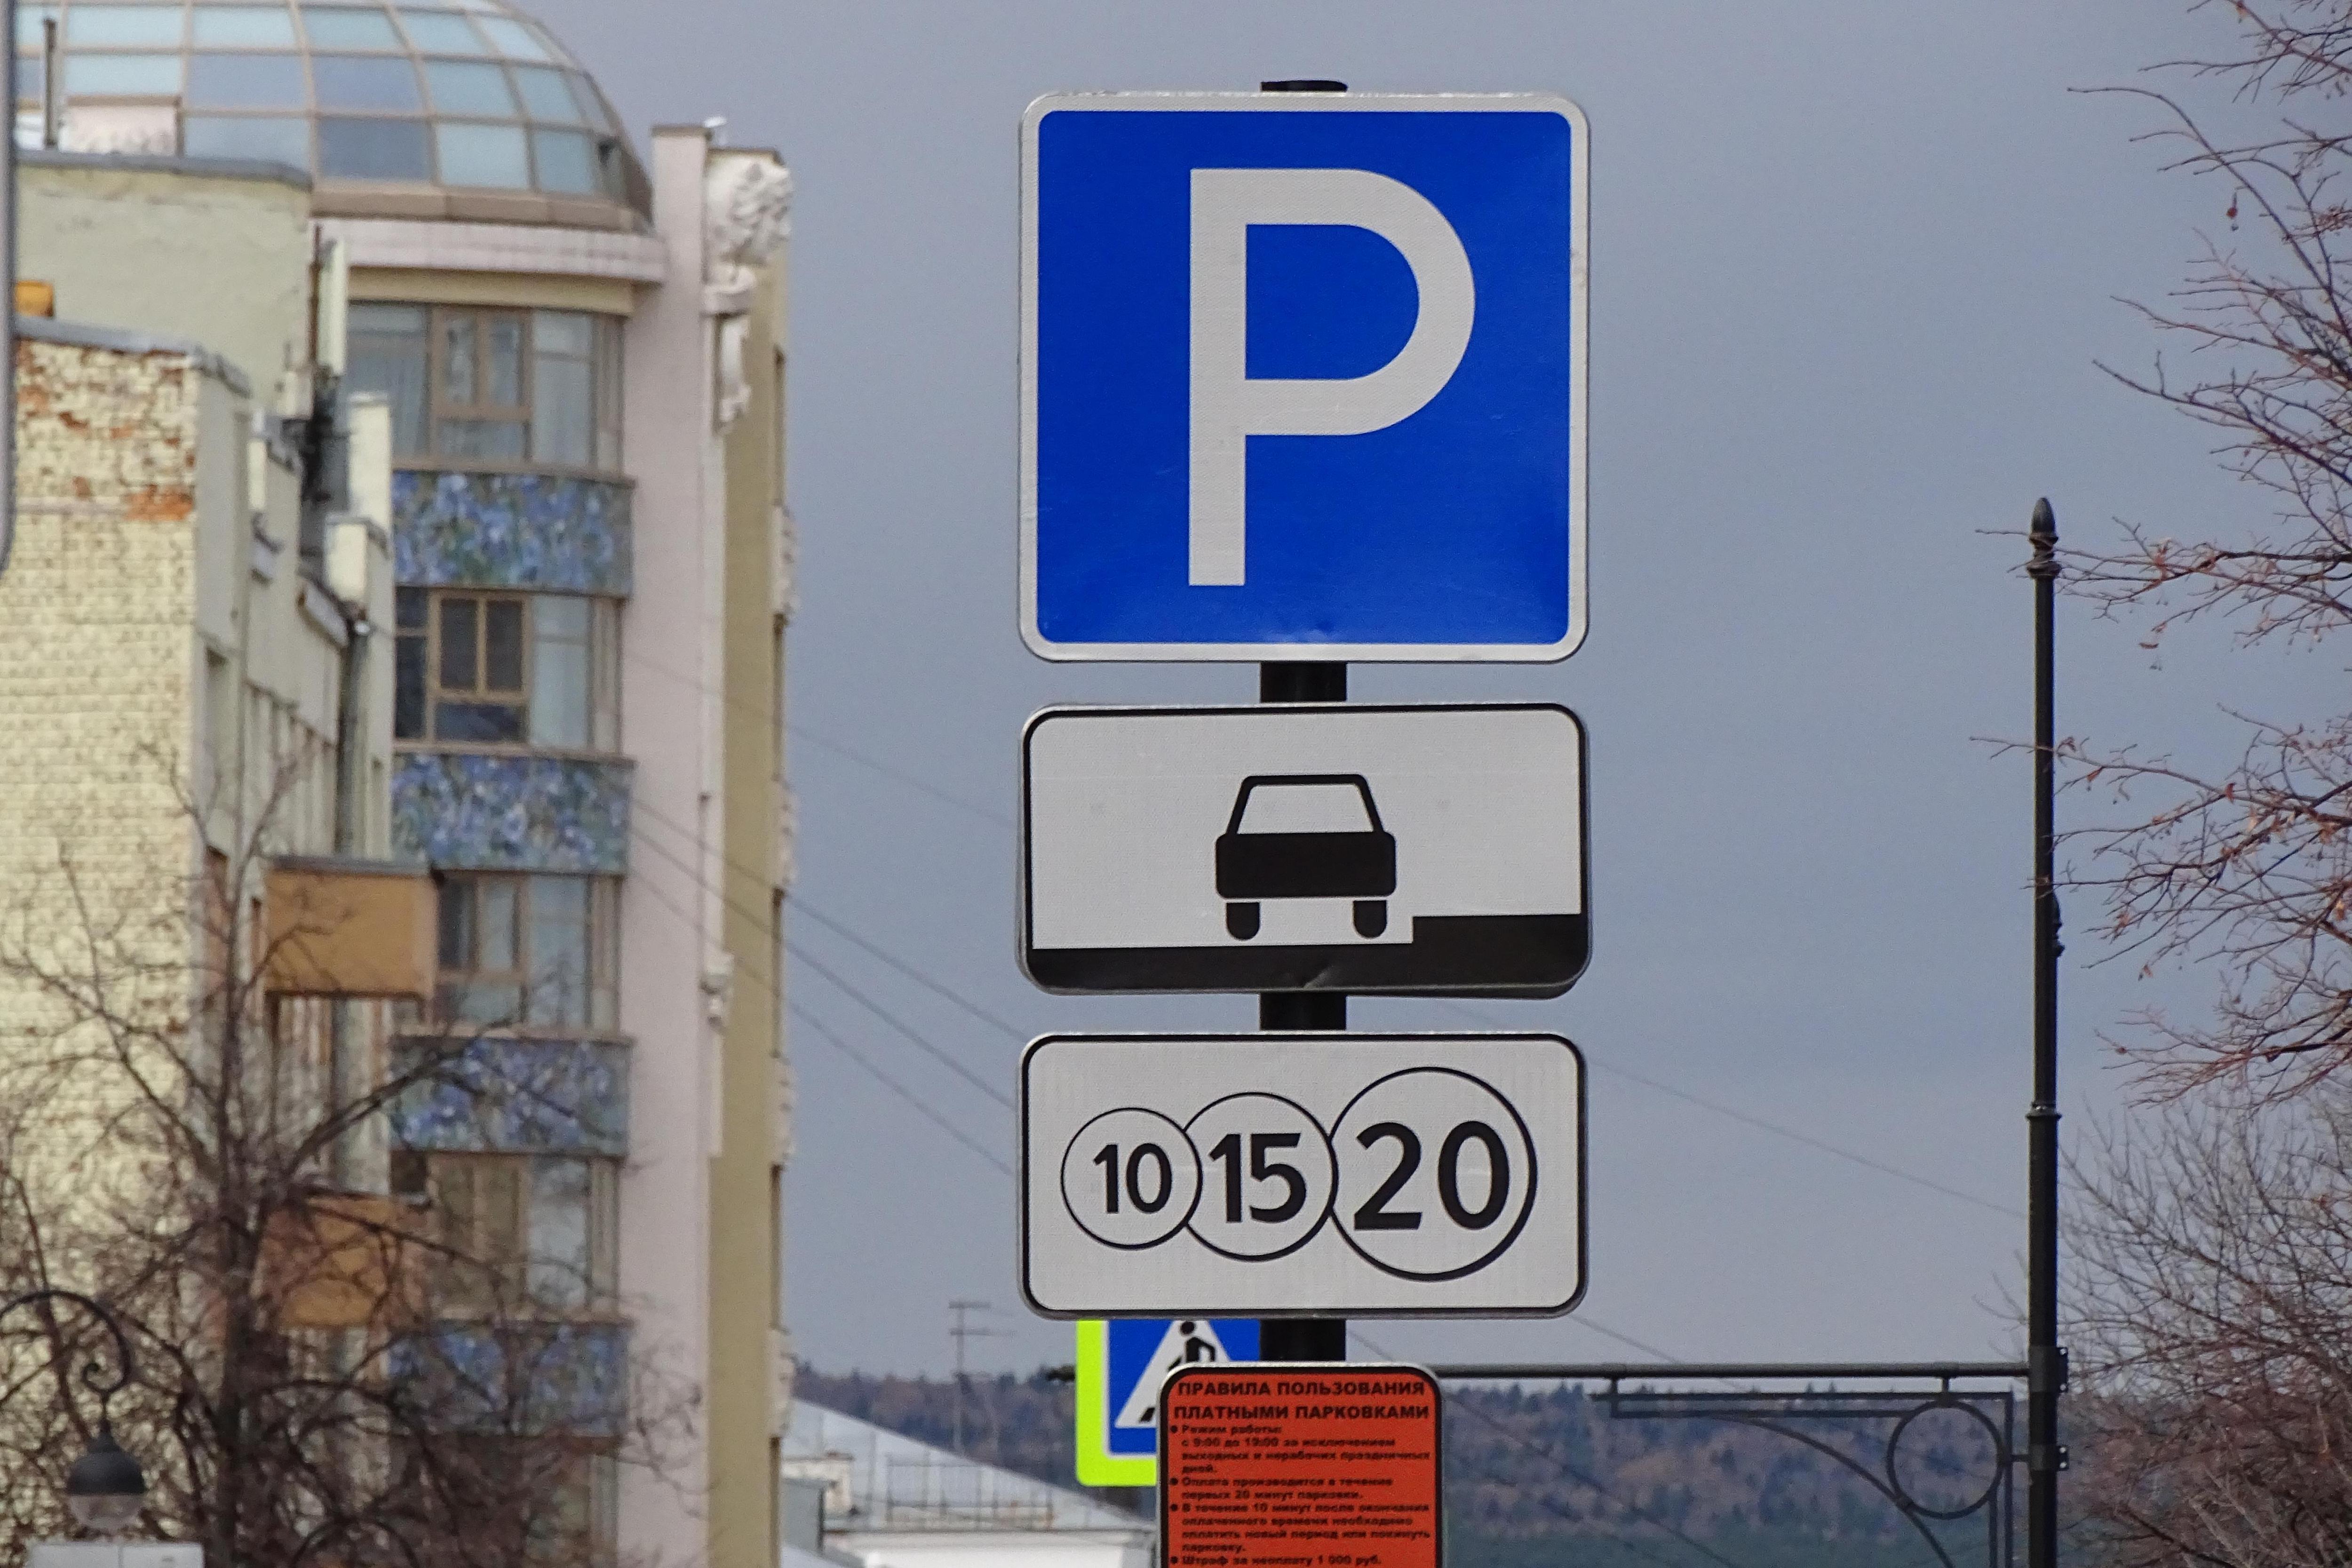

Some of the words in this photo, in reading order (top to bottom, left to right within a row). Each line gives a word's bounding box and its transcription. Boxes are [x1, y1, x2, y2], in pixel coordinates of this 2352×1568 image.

[1189, 168, 1476, 586] P
[1093, 1141, 1173, 1214] 10
[1209, 1132, 1307, 1224] 15
[1353, 1120, 1510, 1230] 20
[1178, 1381, 1271, 1396] ПРАВИЛА
[1277, 1381, 1425, 1396] ПОЛЬЗОВАНИЯ
[1174, 1405, 1289, 1420] ПЛАТНЫМИ
[1295, 1405, 1430, 1419] ПАРКОВКАМИ
[1182, 1425, 1227, 1434] Режим
